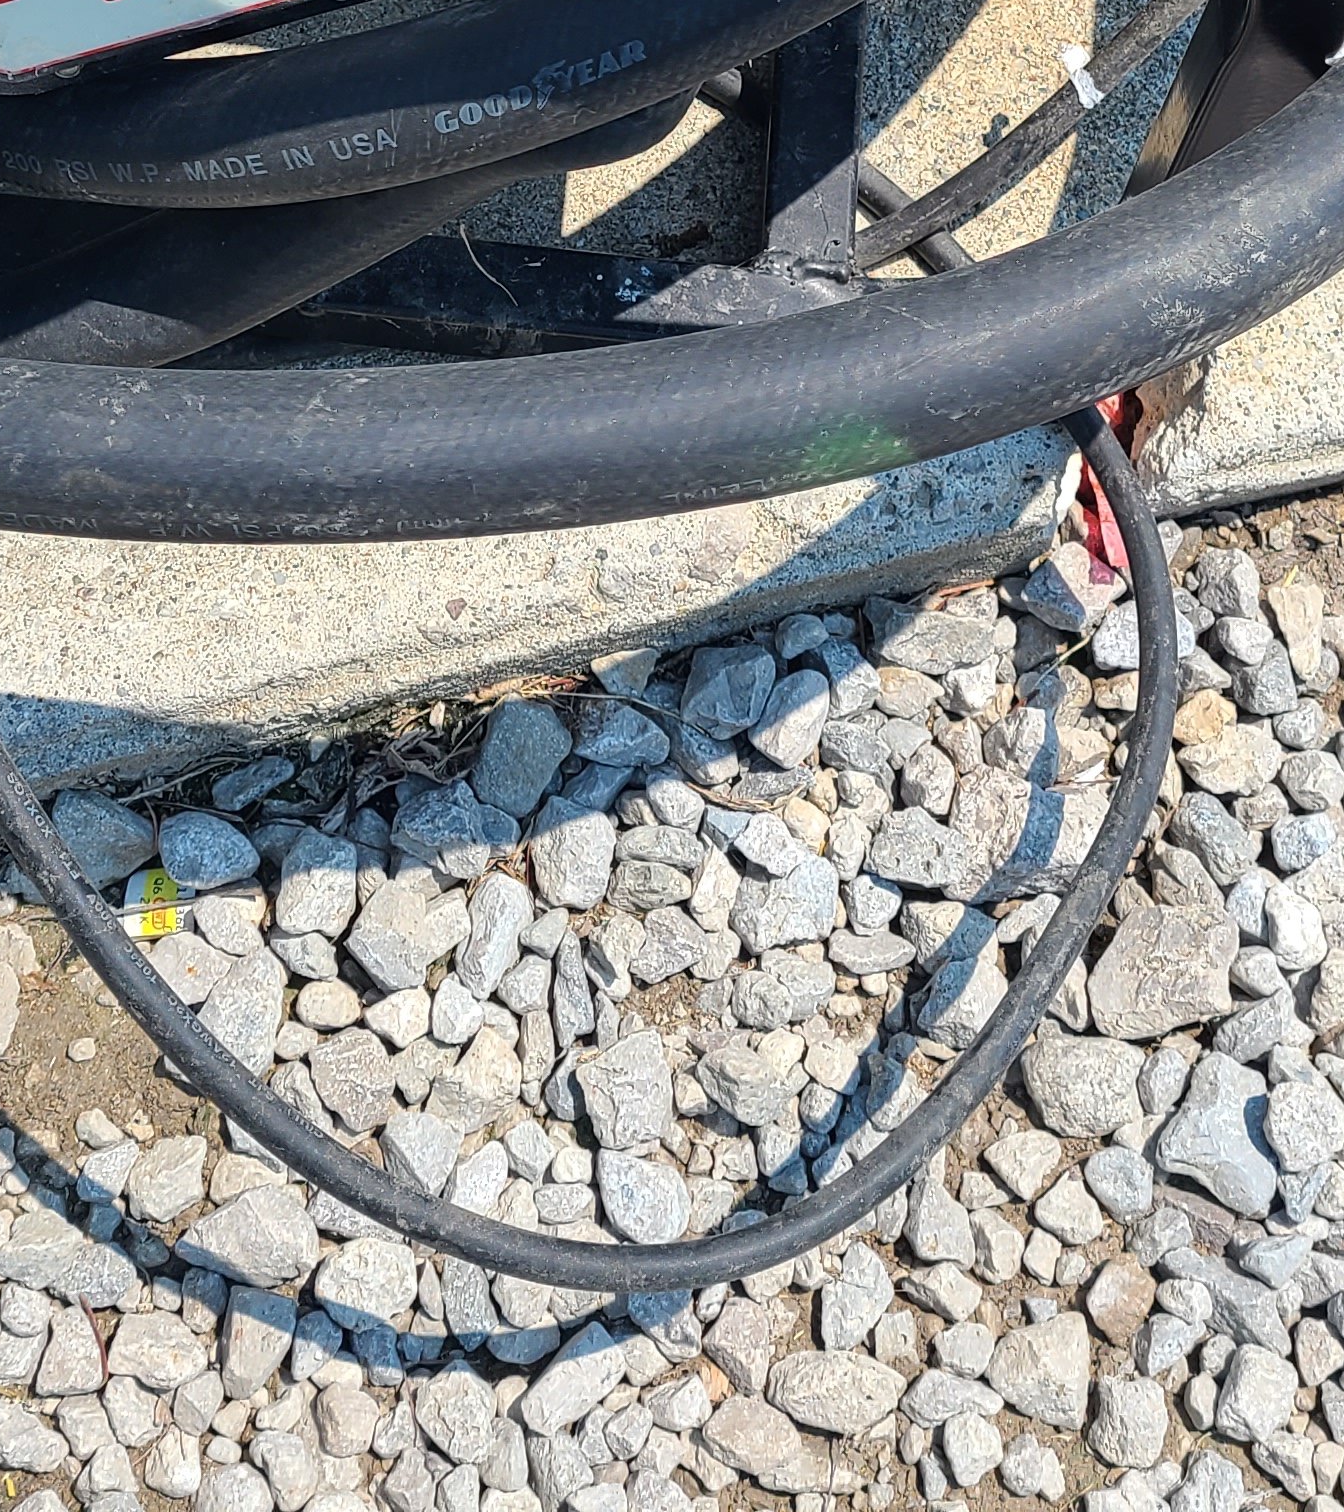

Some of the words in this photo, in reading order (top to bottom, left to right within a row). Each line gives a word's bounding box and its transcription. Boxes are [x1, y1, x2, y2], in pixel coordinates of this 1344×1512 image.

[432, 38, 648, 135] GOODYEAR
[2, 149, 43, 176] 200
[181, 153, 268, 184] MADE
[281, 146, 313, 170] IN
[330, 126, 399, 162] USA
